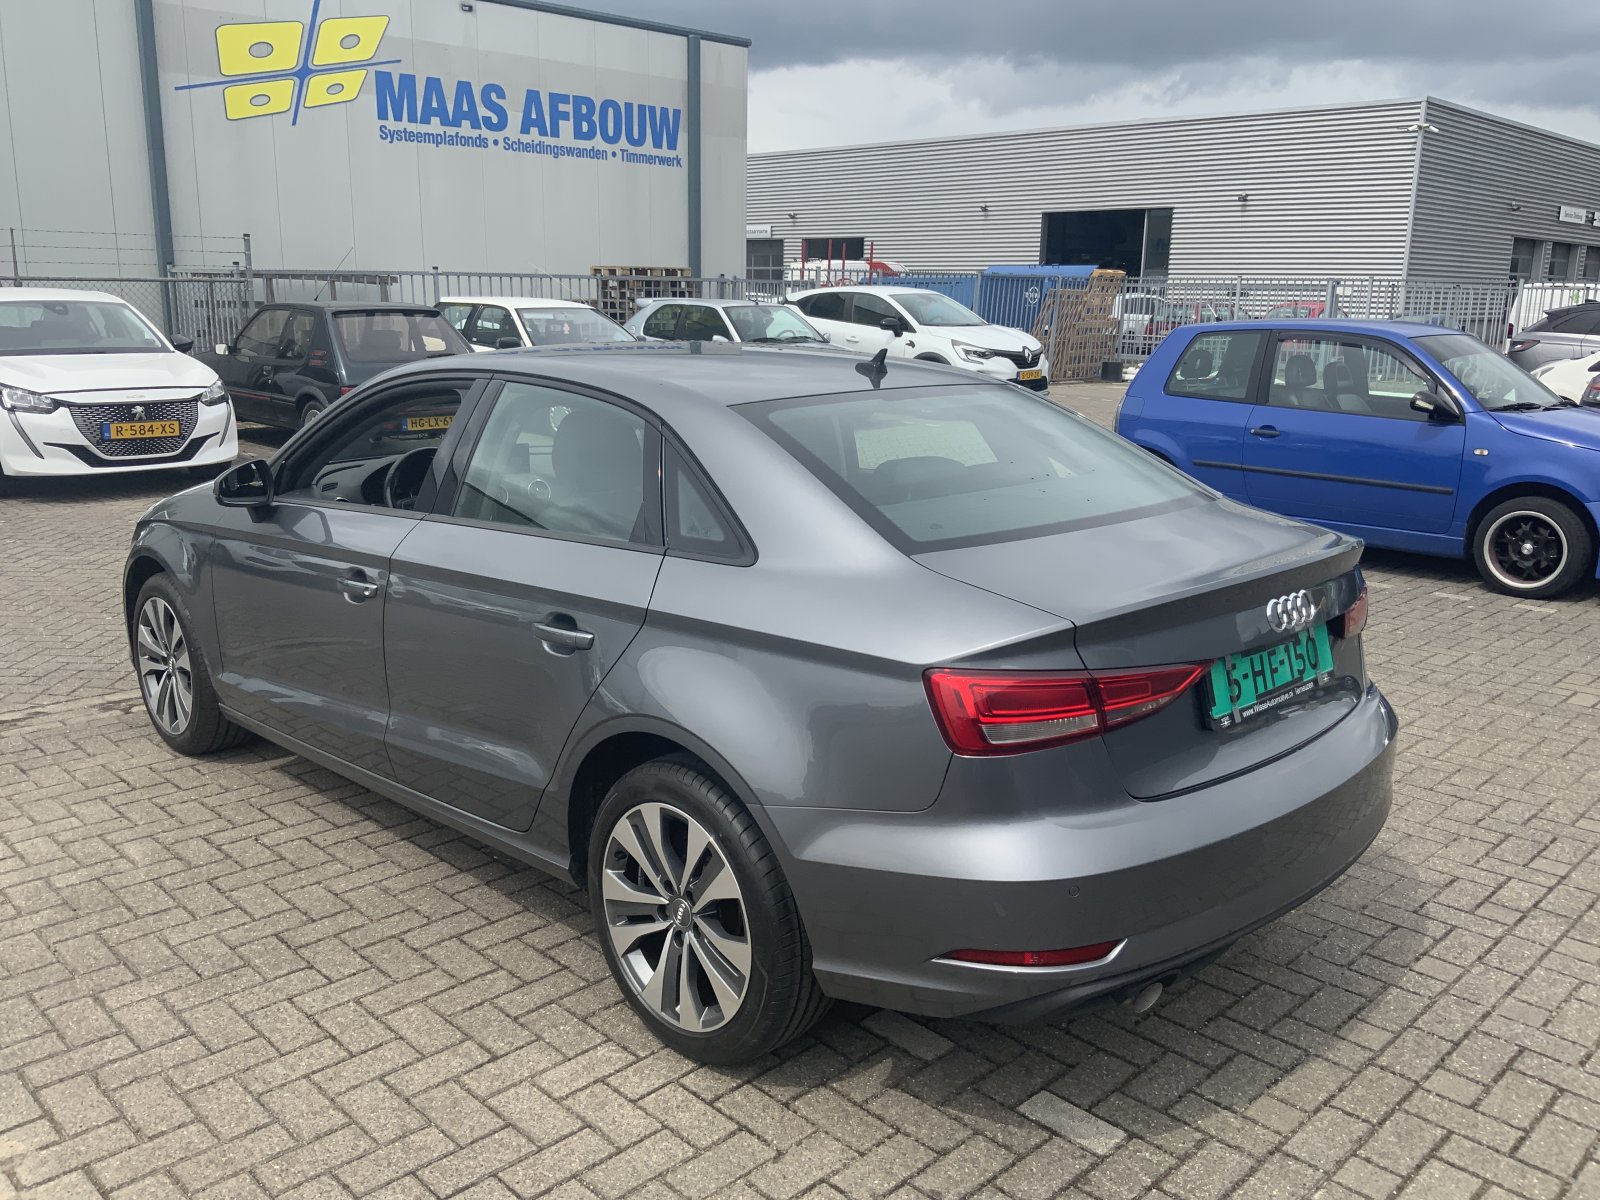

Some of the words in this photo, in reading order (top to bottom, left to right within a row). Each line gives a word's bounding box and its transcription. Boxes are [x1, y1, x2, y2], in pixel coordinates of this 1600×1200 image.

[375, 70, 508, 132] MAAS
[519, 89, 682, 151] AFBOUW
[379, 125, 489, 148] Systeemplafonds
[503, 136, 608, 160] Scheidingswanden
[620, 148, 682, 168] Timmerwerk
[115, 423, 176, 436] R-584-XS
